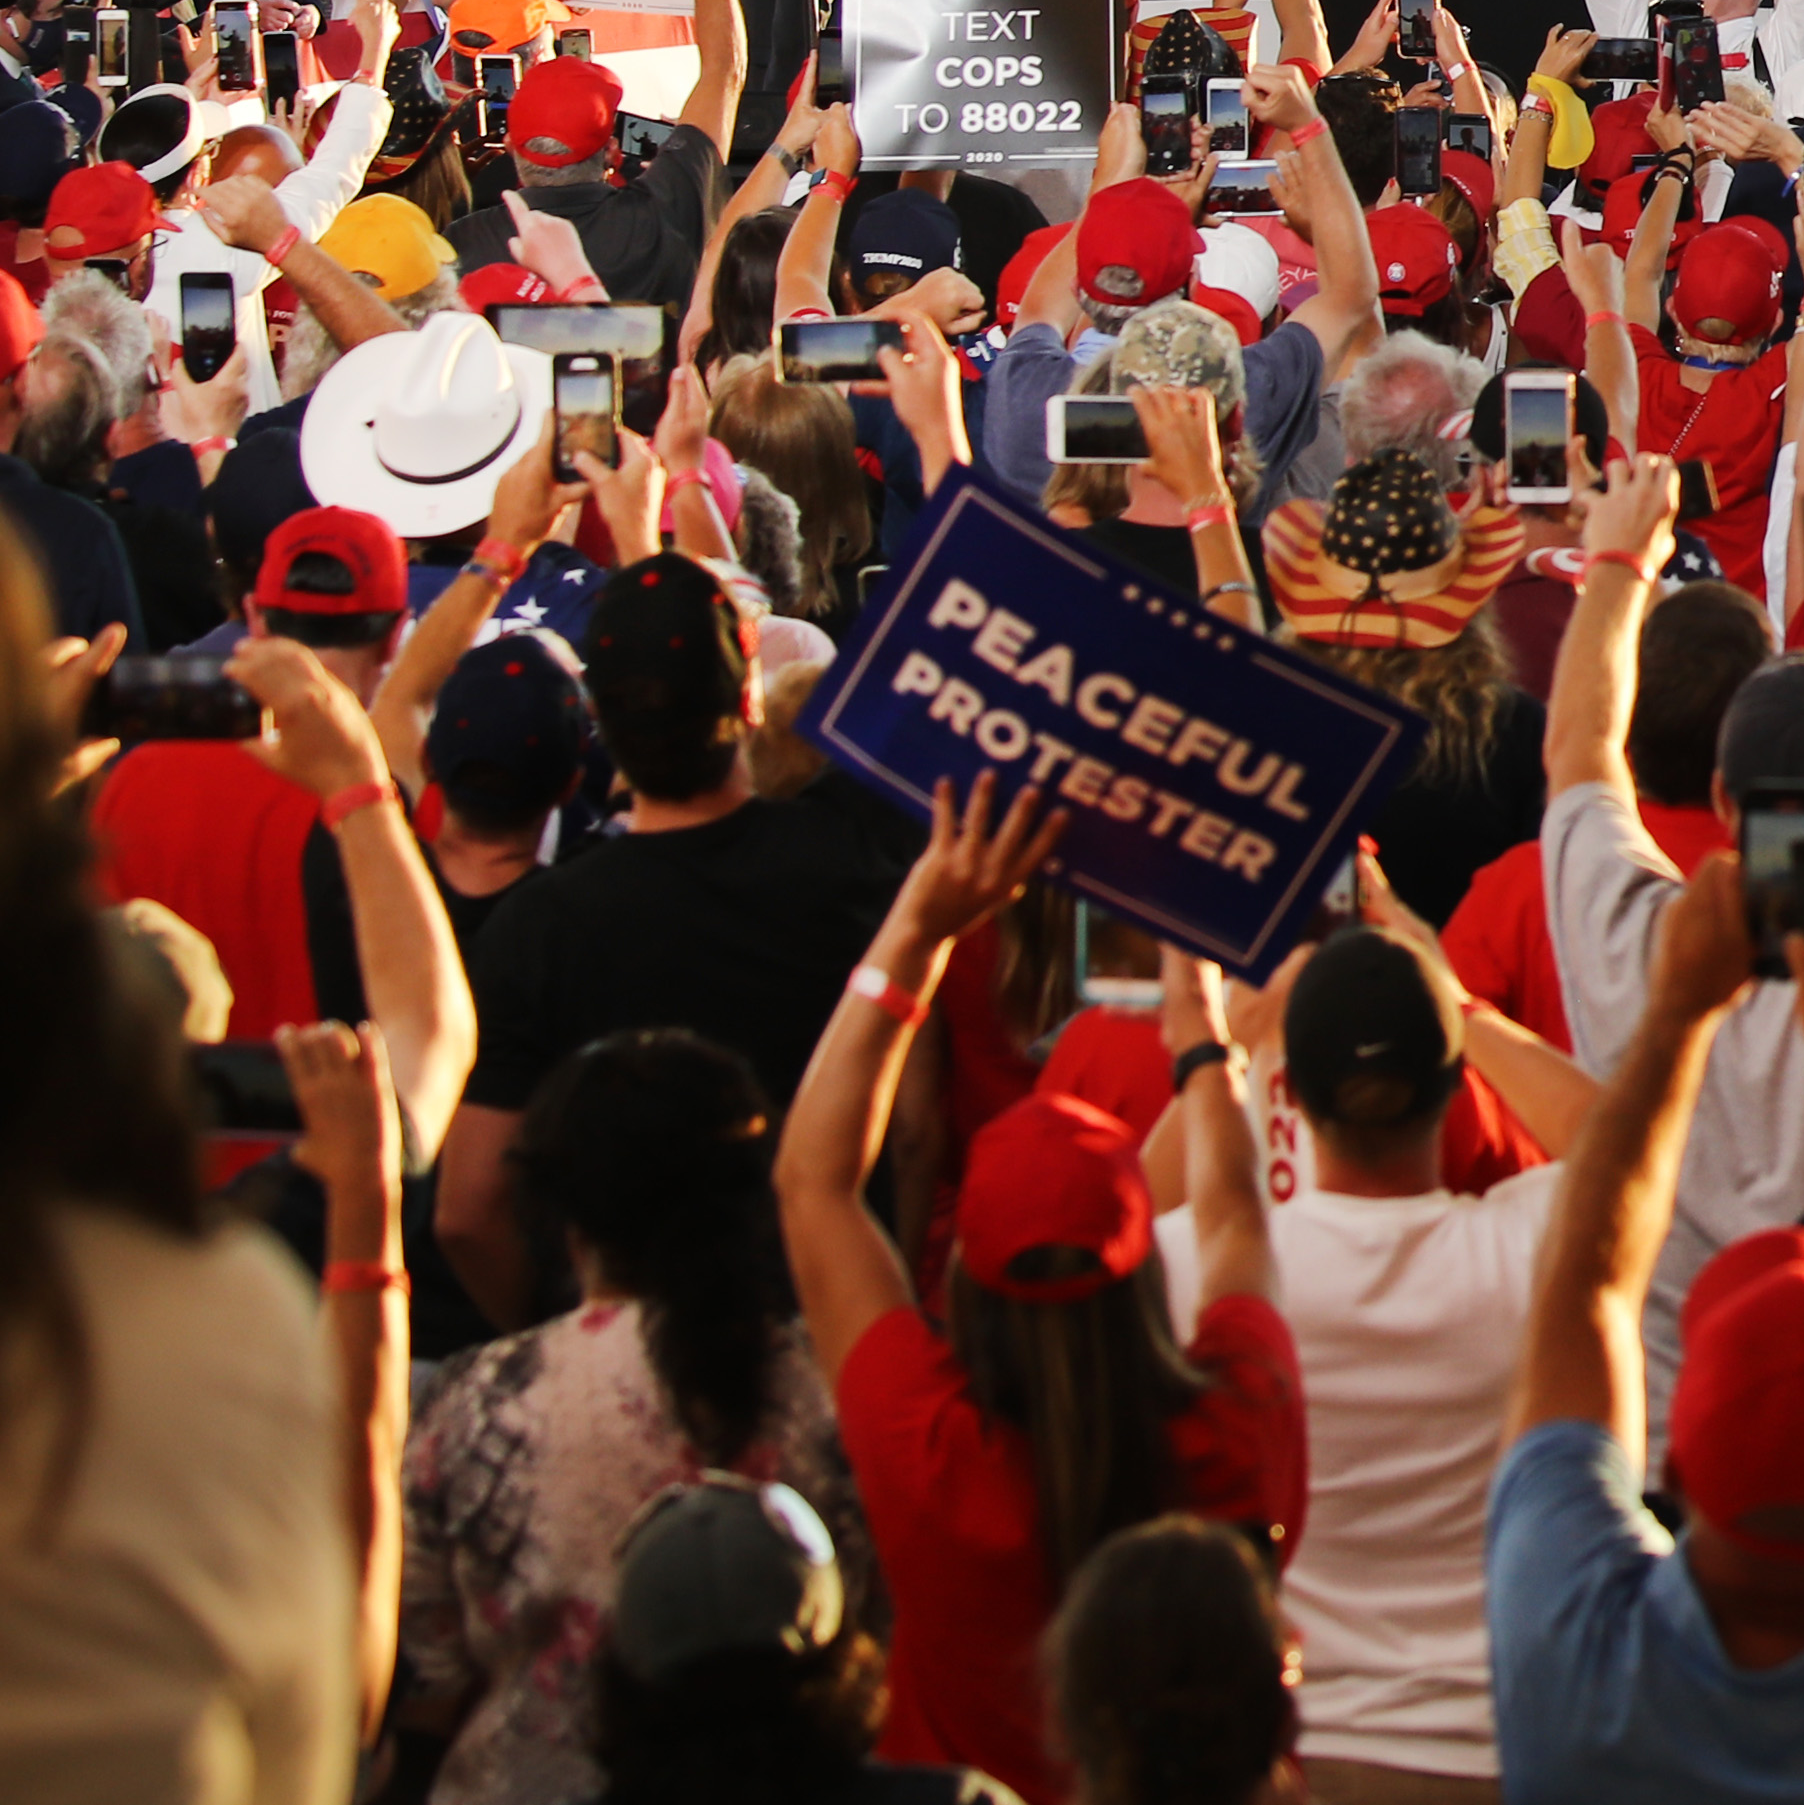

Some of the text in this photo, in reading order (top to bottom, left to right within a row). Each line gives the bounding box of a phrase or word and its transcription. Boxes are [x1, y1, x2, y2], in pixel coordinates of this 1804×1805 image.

[943, 11, 1042, 43] TEXT
[937, 57, 1045, 90] COPS
[894, 99, 1086, 137] TO 88022
[967, 152, 1006, 164] 2020
[926, 576, 1311, 824] PEACEFUL
[890, 649, 1279, 886] PROTESTER
